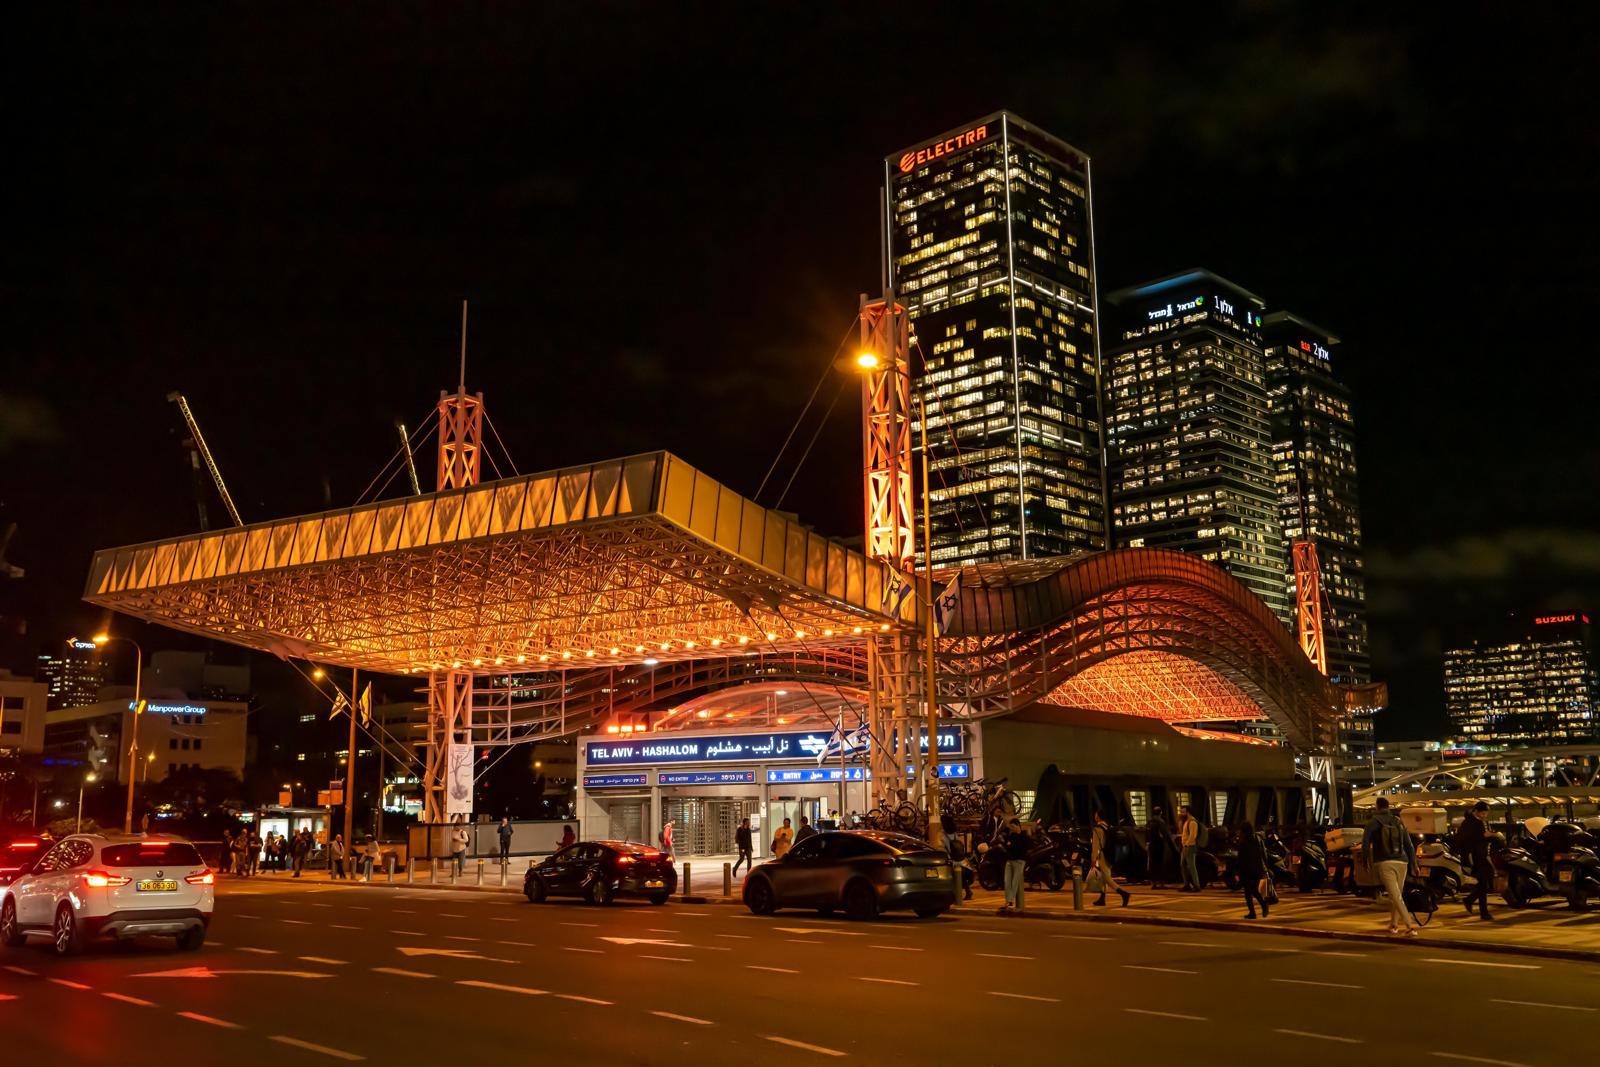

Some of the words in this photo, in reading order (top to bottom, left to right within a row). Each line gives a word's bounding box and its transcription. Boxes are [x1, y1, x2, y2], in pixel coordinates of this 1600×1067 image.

[917, 125, 987, 164] ELECTRA
[1535, 614, 1576, 625] SUZUKI
[147, 704, 206, 715] ManpowerGroup
[592, 748, 610, 759] TEL
[611, 747, 634, 758] AVIV
[642, 744, 699, 757] HASHALOM
[706, 740, 743, 758] هشلوم
[752, 736, 774, 754] أبيب
[776, 738, 789, 754] تل
[783, 772, 801, 780] ENTRY
